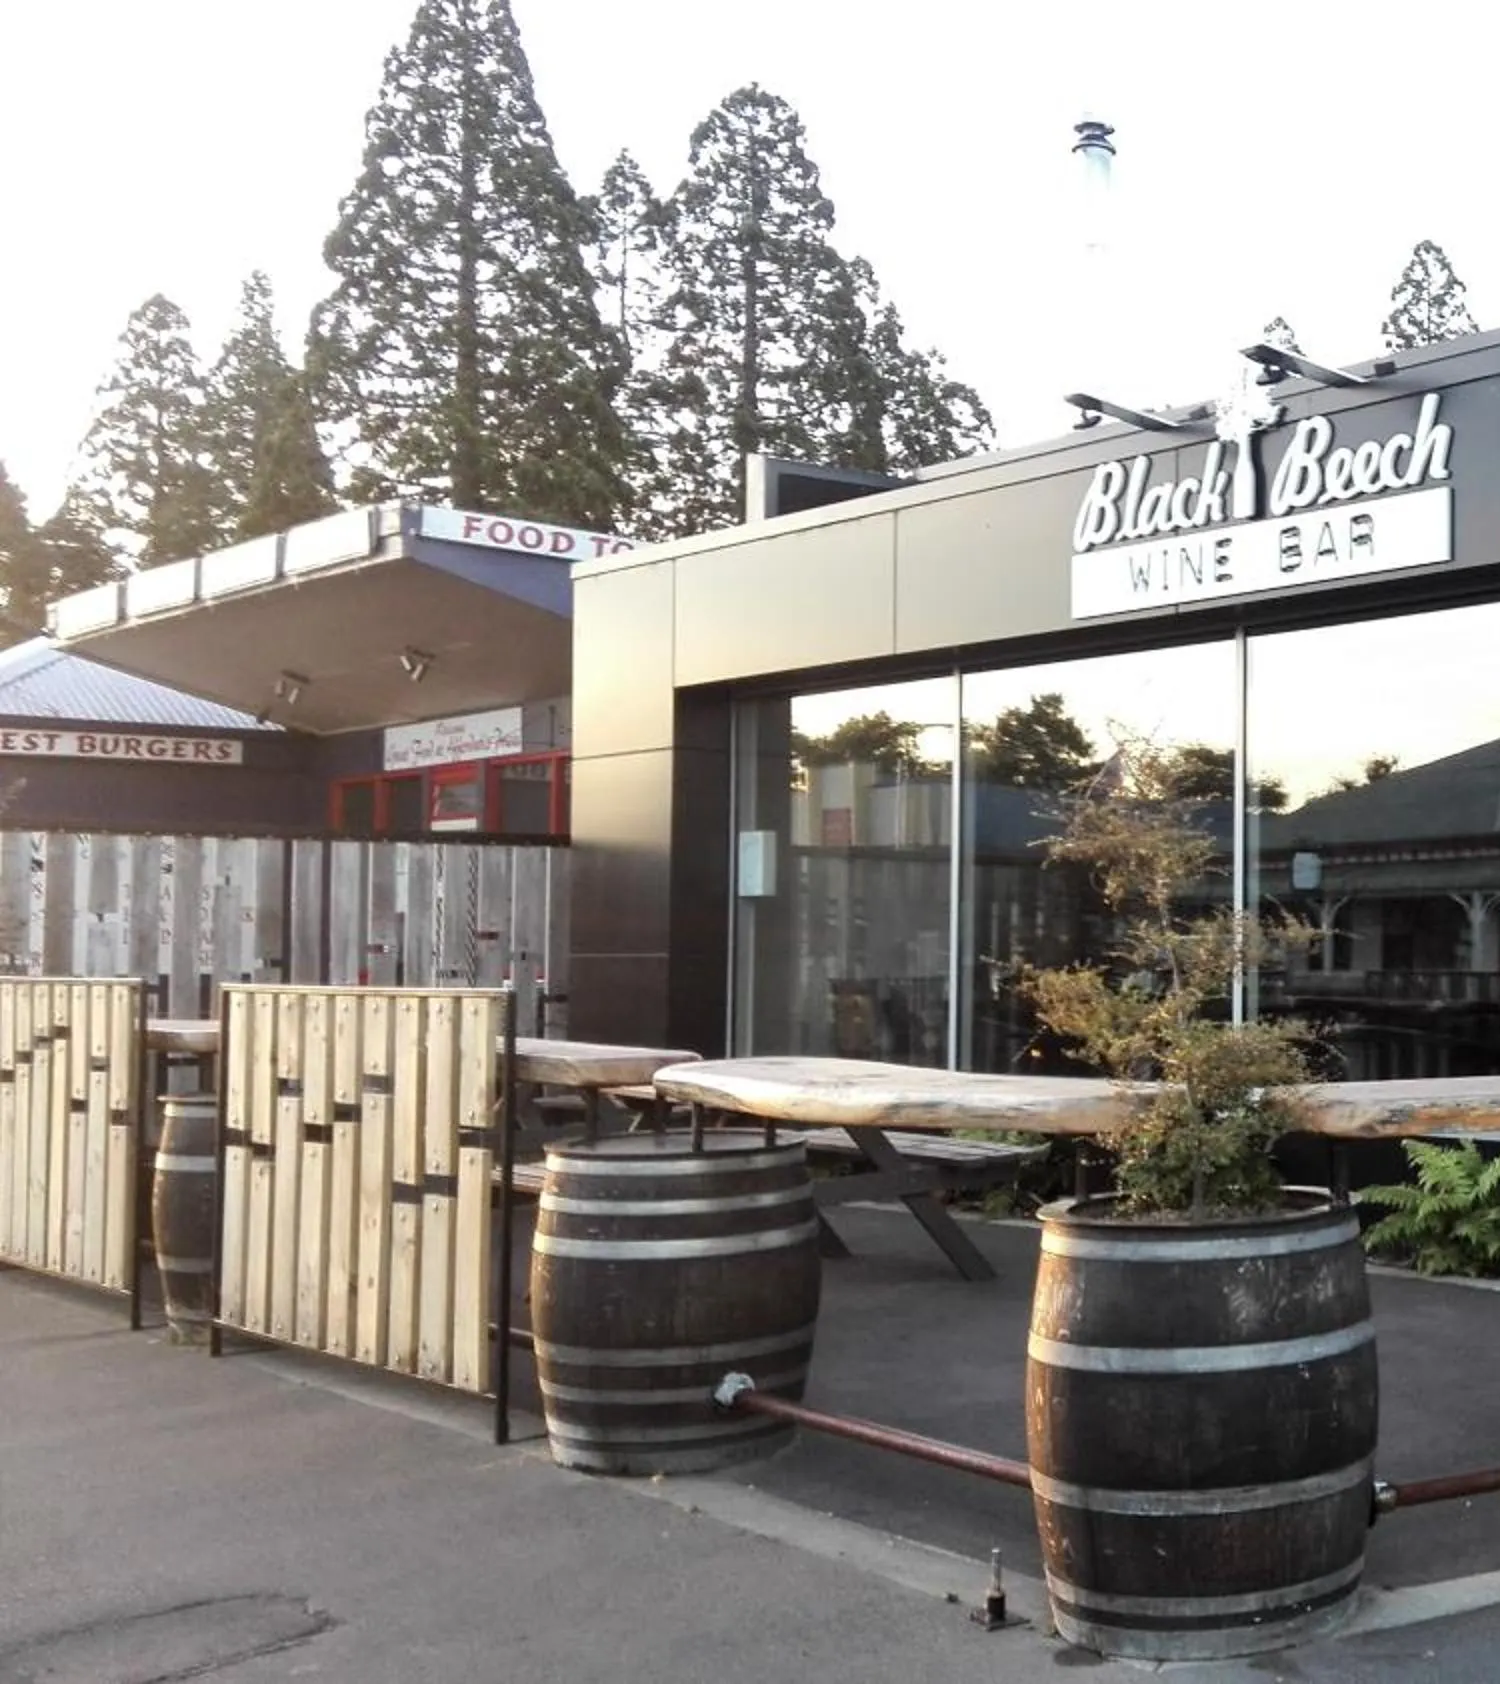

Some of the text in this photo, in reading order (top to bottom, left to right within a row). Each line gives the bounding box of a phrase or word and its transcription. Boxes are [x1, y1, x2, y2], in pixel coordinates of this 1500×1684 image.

[1073, 392, 1453, 552] Black Beech
[462, 515, 576, 553] FOOD
[1128, 512, 1375, 593] WINE BAR
[77, 734, 233, 761] BURGERS
